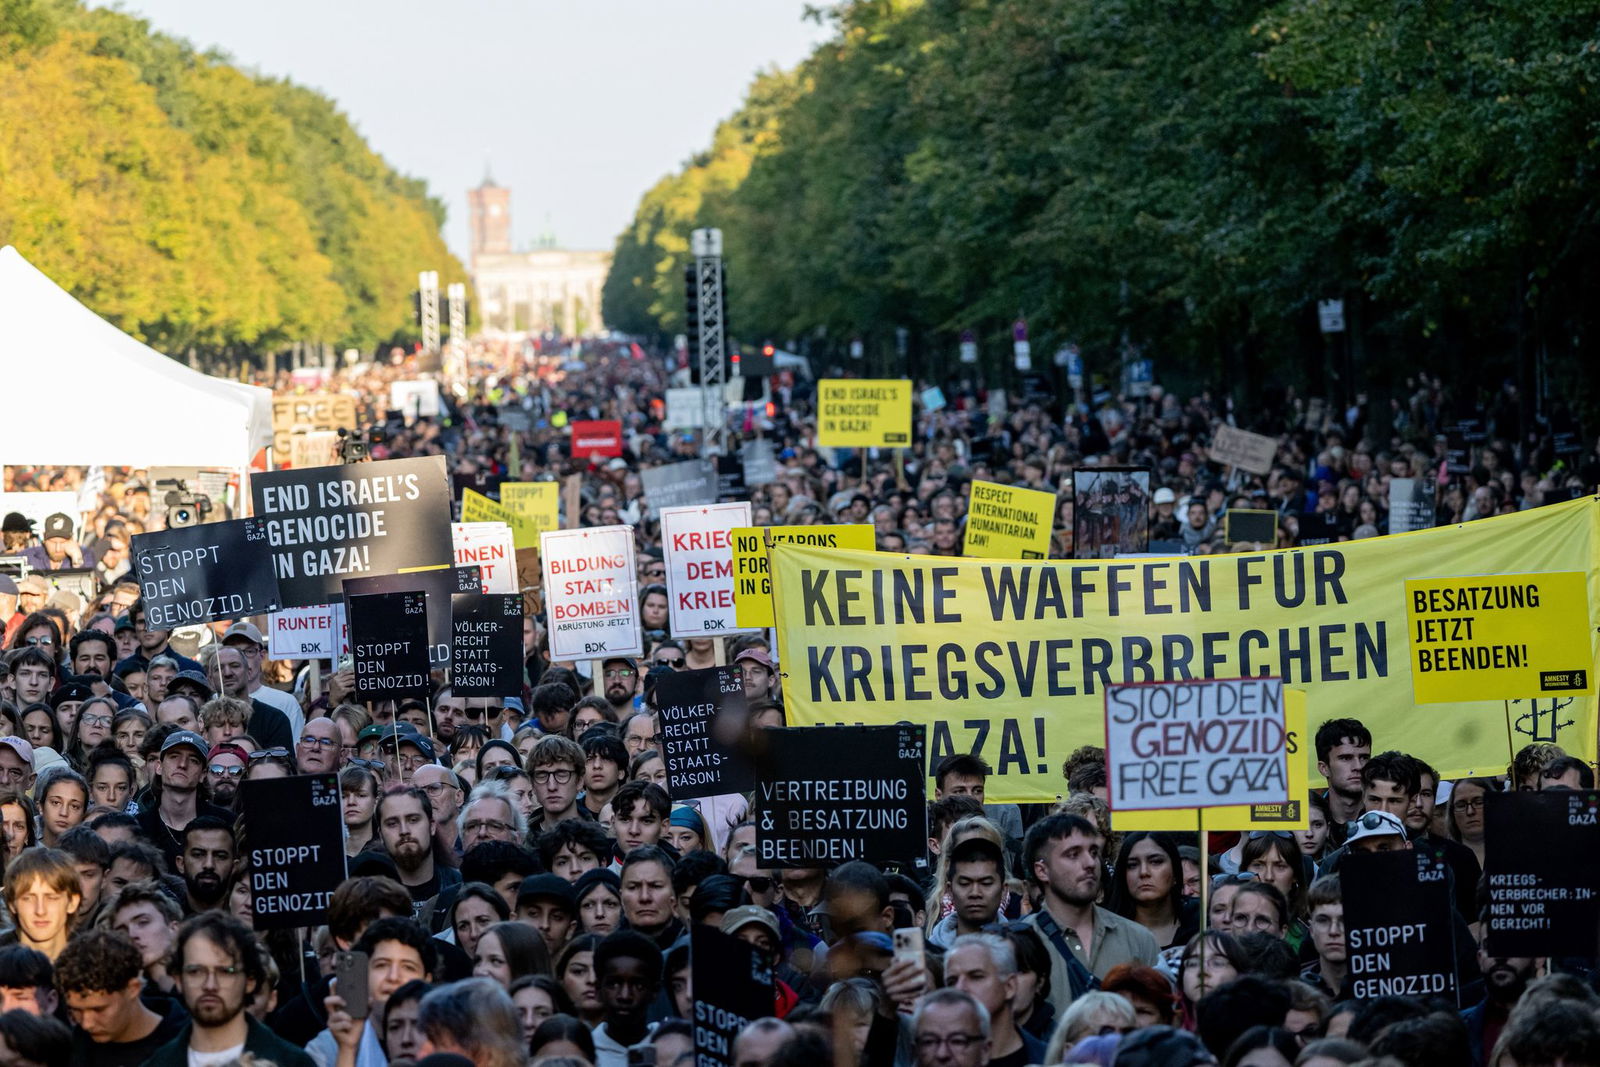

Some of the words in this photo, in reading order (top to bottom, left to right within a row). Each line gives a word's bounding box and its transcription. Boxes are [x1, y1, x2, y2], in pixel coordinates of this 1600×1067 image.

[825, 388, 846, 400] END
[850, 388, 898, 400] ISRAEL'S
[272, 400, 349, 423] FREE
[825, 403, 879, 416] GENOCIDE
[825, 420, 836, 431] IN
[840, 419, 872, 431] GAZA!
[262, 484, 310, 513] END
[318, 474, 420, 508] ISRAEL'S
[504, 488, 542, 499] STOPPT
[974, 486, 1012, 504] RESPECT
[973, 502, 1038, 525] INTERNATIONAL
[247, 532, 266, 541] GAZA
[266, 510, 387, 546] GENOCIDE
[970, 517, 1036, 540] HUMANITARIAN
[738, 536, 758, 552] NO
[968, 532, 989, 548] LAW!
[141, 546, 219, 574] STOPPT
[302, 545, 370, 576] GAZA!
[551, 555, 625, 574] BILDUNG
[740, 557, 768, 574] FOR
[687, 561, 732, 580] DEM
[145, 577, 186, 599] DEN
[565, 578, 614, 595] STATT
[741, 579, 755, 595] IN
[801, 567, 962, 626] KEINE
[981, 560, 1212, 622] WAFFEN
[1237, 550, 1348, 610] FÜR
[1414, 584, 1540, 613] BESATZUNG
[150, 592, 253, 624] GENOZID!
[555, 599, 630, 619] BOMBEN
[455, 621, 503, 632] VÖLKER-
[607, 618, 630, 627] JETZT
[704, 620, 725, 630] BDK
[1416, 617, 1474, 643] JETZT
[301, 643, 320, 653] BDK
[357, 642, 410, 657] STOPPT
[455, 636, 490, 646] RECHT
[585, 641, 607, 653] BDK
[455, 649, 490, 659] STATT
[807, 621, 1388, 702] KRIEGSVERBRECHEN
[1418, 645, 1528, 672] BEENDEN!
[357, 661, 385, 674] DEN
[455, 663, 503, 673] STAATS-
[359, 674, 430, 690] GENOZID!
[455, 675, 495, 687] RÄSON!
[720, 684, 741, 693] GAZA
[1110, 684, 1213, 724] STOPT
[1217, 681, 1282, 716] DEN
[662, 703, 722, 720] VÖLKER-
[665, 721, 707, 737] RECHT
[667, 737, 709, 754] STATT
[1131, 718, 1286, 758] GENOZID
[895, 717, 1048, 777] AZA!
[898, 749, 921, 759] GAZA
[669, 753, 728, 771] STAATS-
[671, 770, 720, 787] RÄSON!
[1119, 760, 1200, 800] FREE
[1207, 757, 1287, 795] GAZA
[761, 779, 907, 801] VERTREIBUNG
[313, 796, 337, 806] GAZA
[761, 810, 774, 830] &
[789, 809, 907, 830] BESATZUNG
[1568, 814, 1596, 825] GAZA
[252, 845, 320, 867] STOPPT
[762, 839, 864, 859] BEENDEN!
[254, 871, 288, 890] DEN
[1418, 871, 1444, 882] GAZA
[1490, 874, 1542, 886] KRIEGS-
[1490, 888, 1596, 900] VERBRECHER:IN-
[1491, 904, 1515, 915] NEN
[1521, 903, 1545, 914] VOR
[1491, 918, 1551, 930] GERICHT!
[1350, 924, 1426, 948] STOPPT
[1351, 953, 1390, 974] DEN
[1353, 973, 1454, 999] GENOZID!
[696, 1026, 728, 1056] DEN
